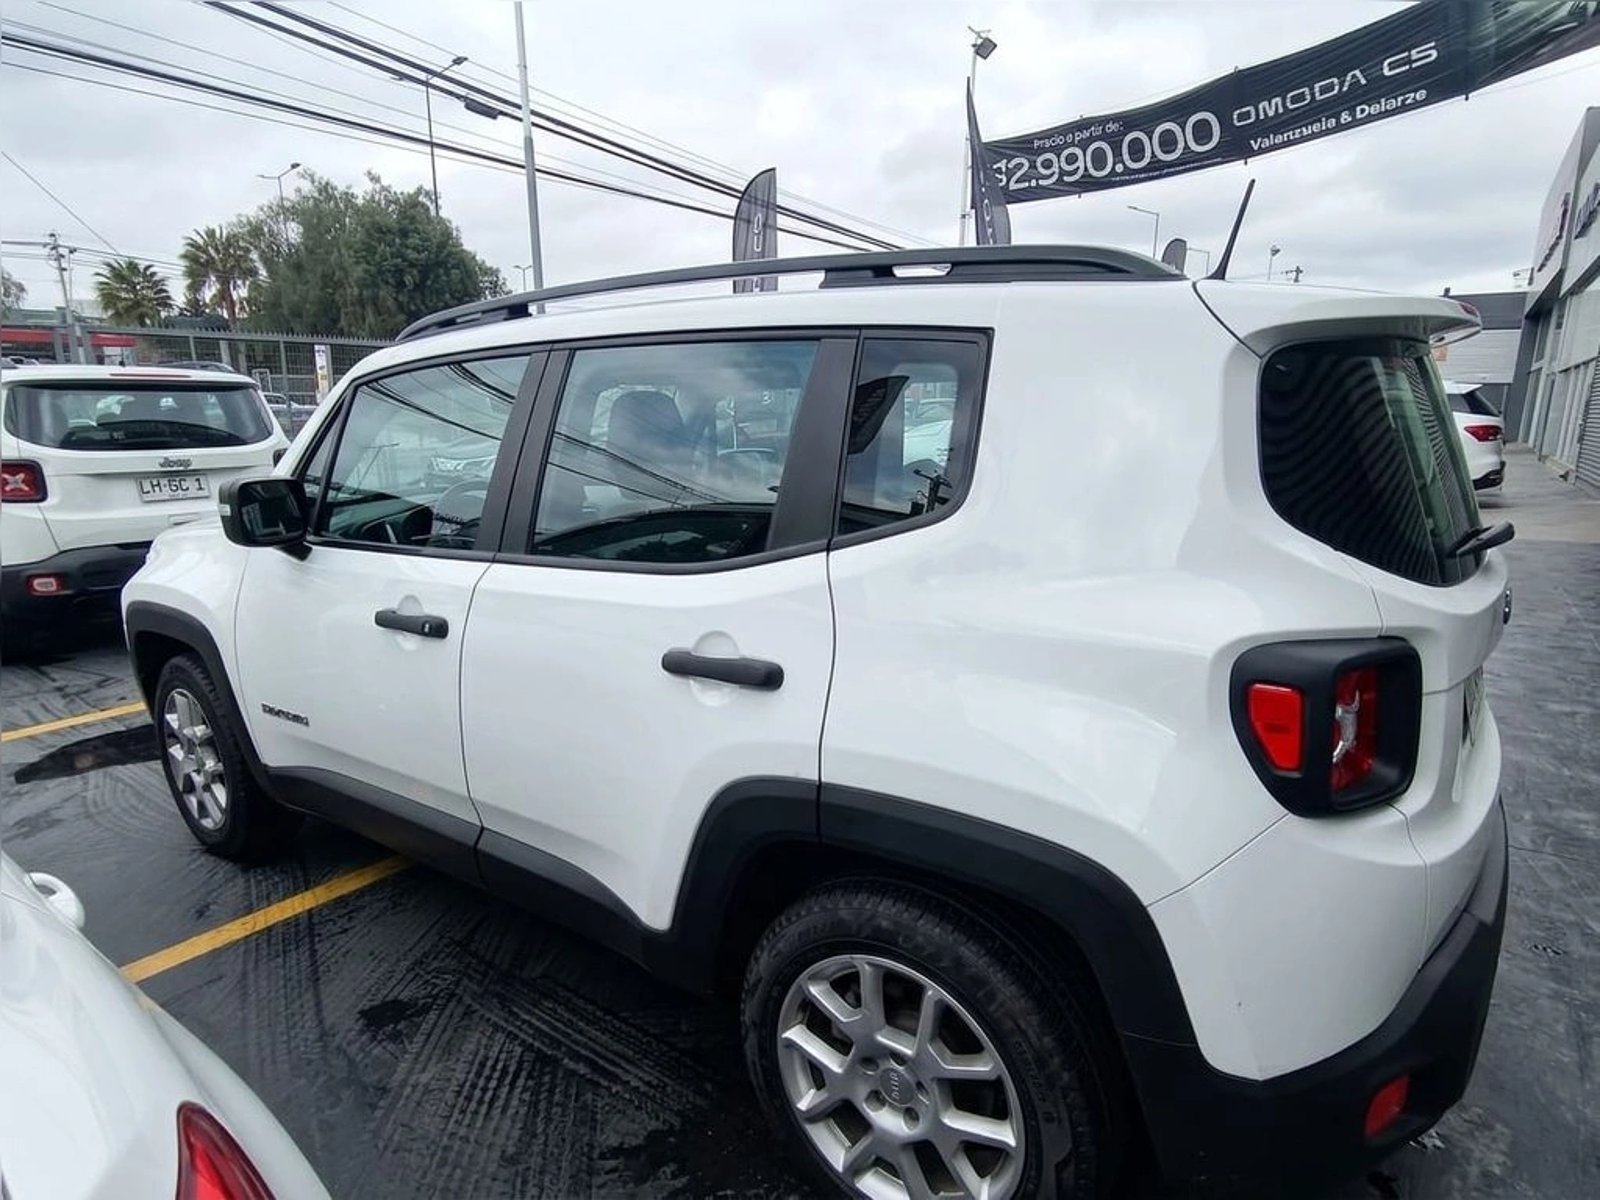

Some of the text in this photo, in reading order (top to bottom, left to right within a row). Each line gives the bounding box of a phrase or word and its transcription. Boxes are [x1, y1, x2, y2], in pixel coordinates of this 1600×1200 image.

[1232, 41, 1438, 126] OMODA C5
[1340, 110, 1352, 124] &
